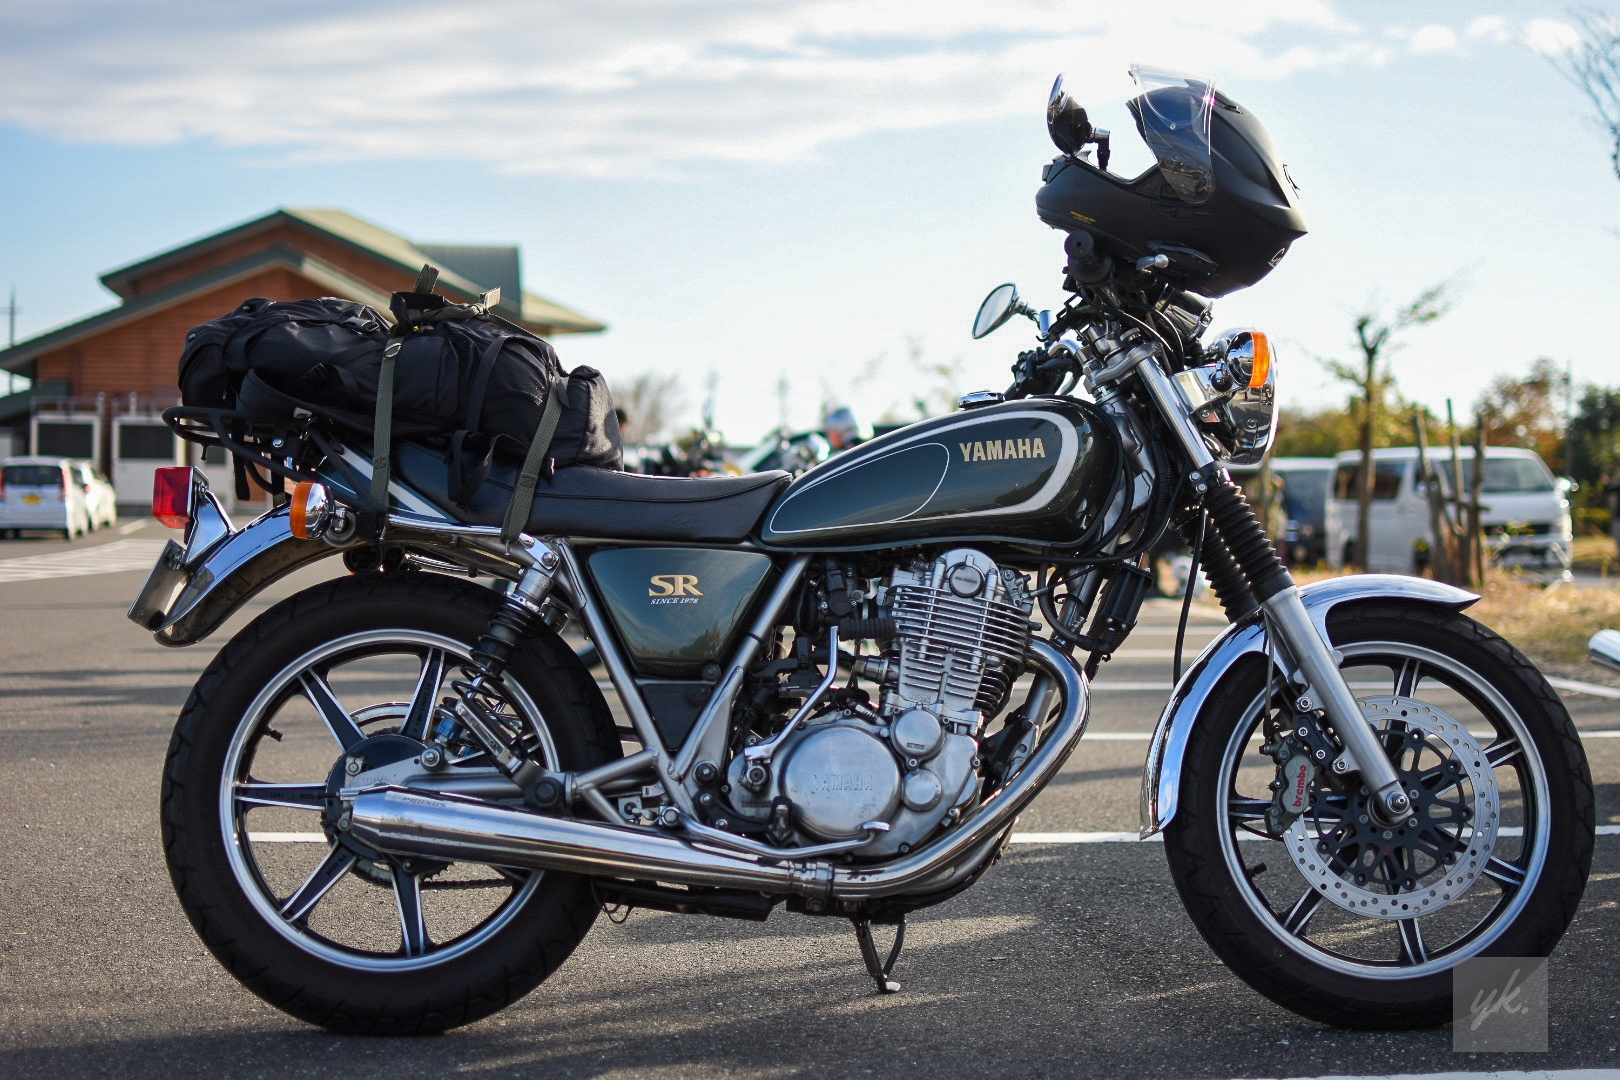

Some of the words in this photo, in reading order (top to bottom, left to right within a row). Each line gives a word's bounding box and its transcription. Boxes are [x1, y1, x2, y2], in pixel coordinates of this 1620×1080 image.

[959, 438, 1046, 462] YAMAHA
[648, 574, 704, 597] SR
[812, 774, 873, 791] YAMAHA
[1292, 764, 1307, 808] brembo
